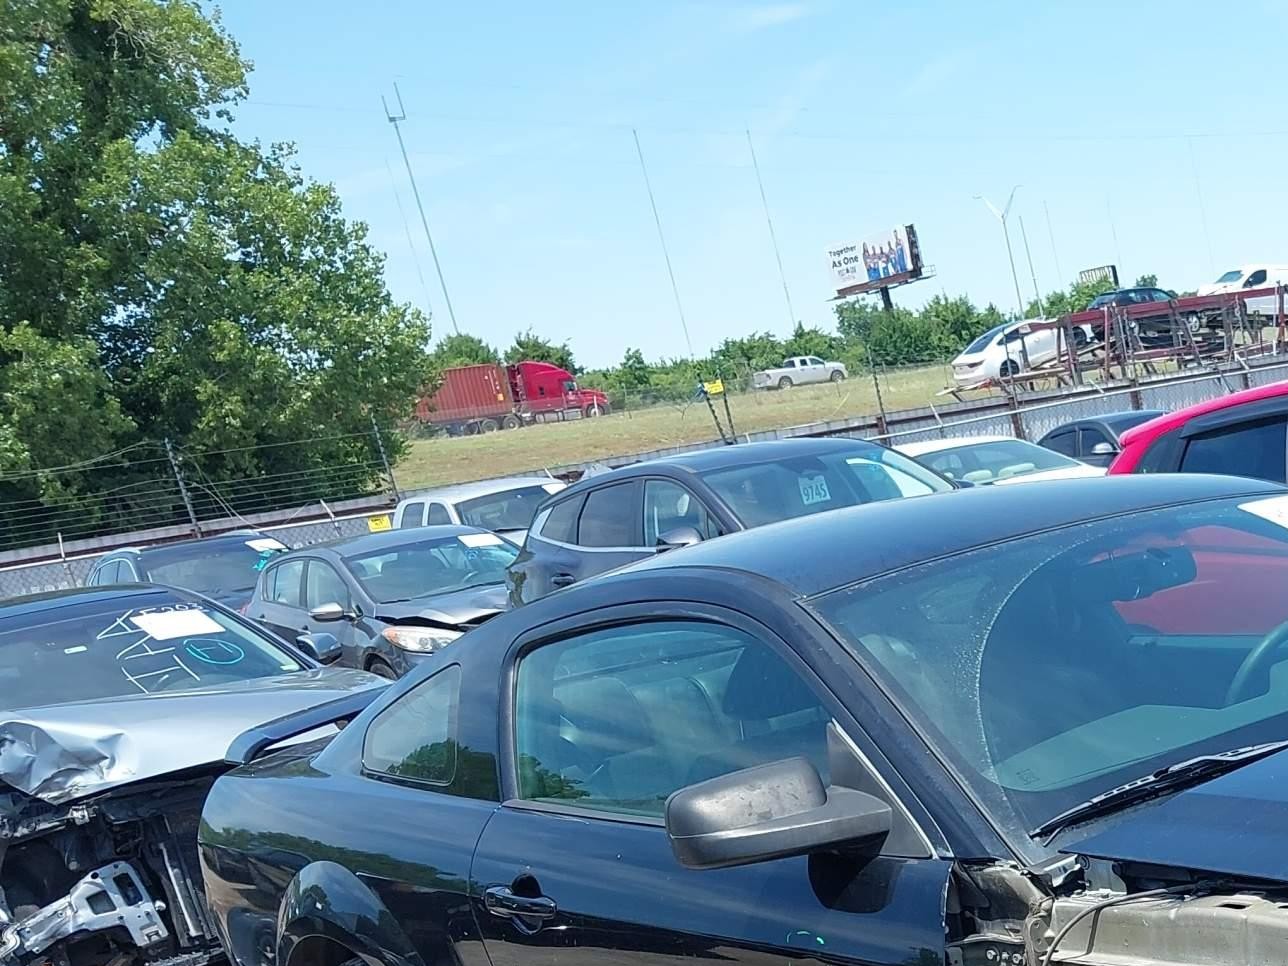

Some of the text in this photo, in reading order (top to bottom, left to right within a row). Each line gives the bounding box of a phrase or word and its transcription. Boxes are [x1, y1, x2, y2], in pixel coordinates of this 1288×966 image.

[828, 245, 856, 258] Together
[832, 255, 859, 269] As One
[803, 482, 828, 502] 9745
